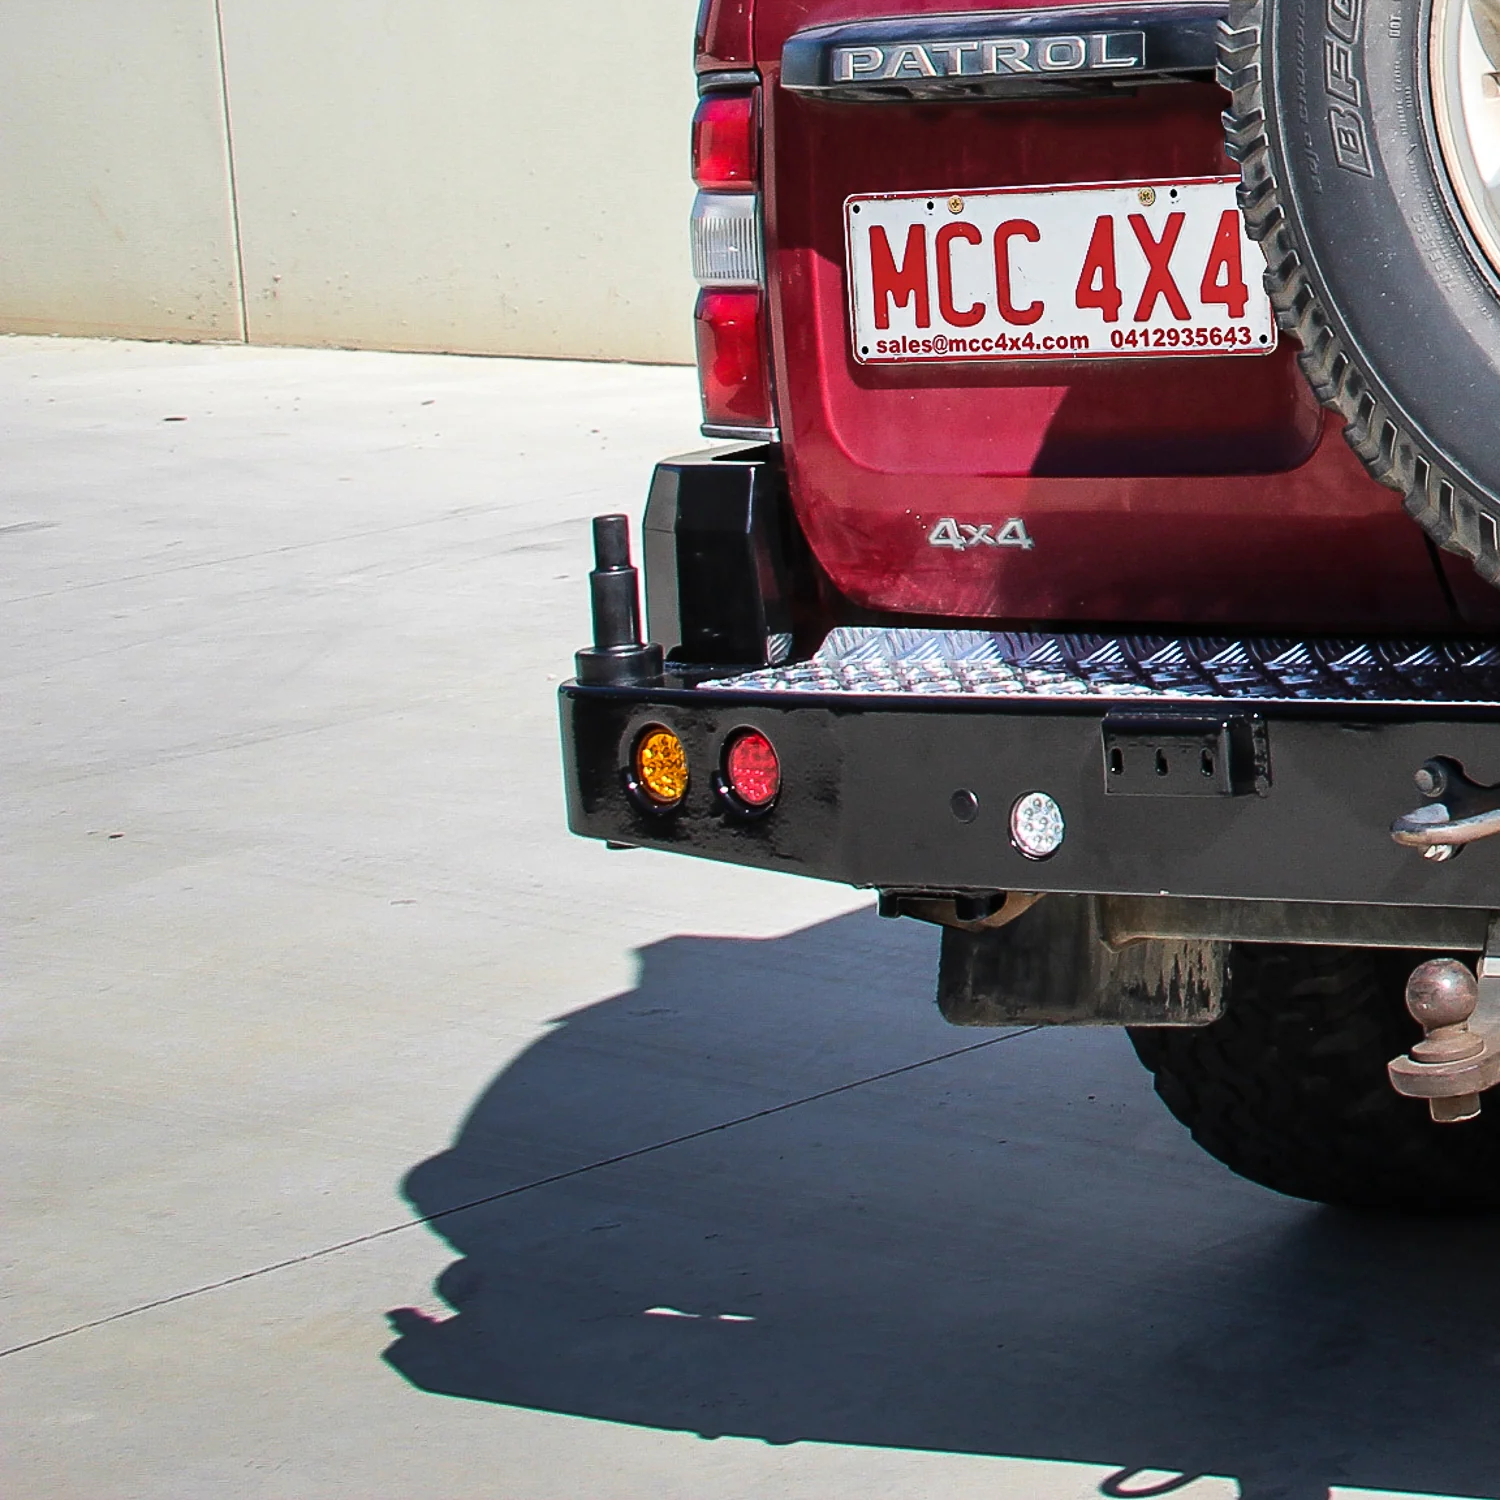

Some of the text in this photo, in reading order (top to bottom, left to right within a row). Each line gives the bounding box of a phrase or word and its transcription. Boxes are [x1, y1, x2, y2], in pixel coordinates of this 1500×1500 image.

[837, 33, 1139, 82] PATROL
[868, 209, 1250, 330] MCC 4X4
[876, 326, 1252, 355] sales@mcc4x4.com 0412935643
[928, 517, 1034, 552] 4x4
